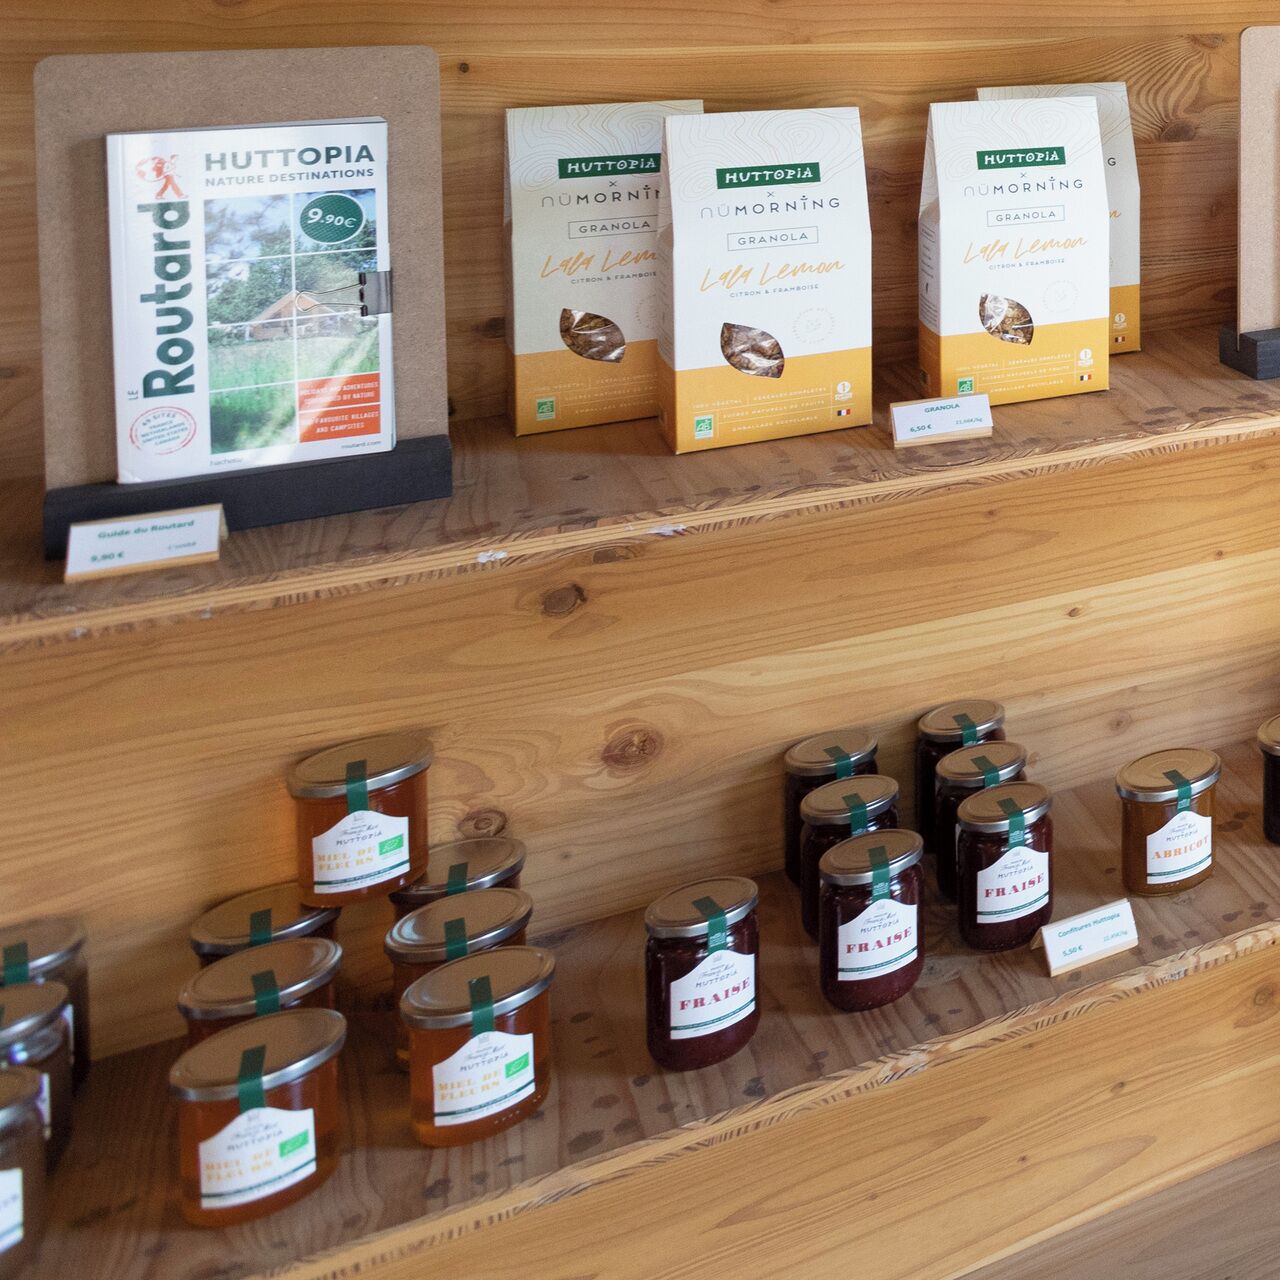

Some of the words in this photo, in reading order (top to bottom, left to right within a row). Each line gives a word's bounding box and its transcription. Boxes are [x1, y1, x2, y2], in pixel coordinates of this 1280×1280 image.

[205, 145, 375, 171] HUTTOPIA
[567, 158, 656, 172] HUTTOPIA
[984, 151, 1059, 165] HUTTOPIA
[206, 175, 264, 186] NATURE
[270, 169, 374, 182] DESTINATIONS
[725, 168, 813, 183] HUTTOPIA
[996, 211, 1056, 221] GRANOLA
[579, 220, 650, 233] GRANOLA
[738, 232, 808, 245] GRANOLA
[1014, 237, 1089, 259] Lemon
[759, 260, 846, 285] Lemon
[773, 284, 819, 293] FRAMBOISE
[138, 201, 195, 398] Routard
[924, 403, 959, 413] GRANOLA
[151, 520, 194, 532] Routard
[1152, 835, 1209, 859] ABRICOT
[985, 873, 1044, 897] FRAISE
[847, 927, 911, 953] FRAISE
[680, 977, 750, 1010] FRAISE
